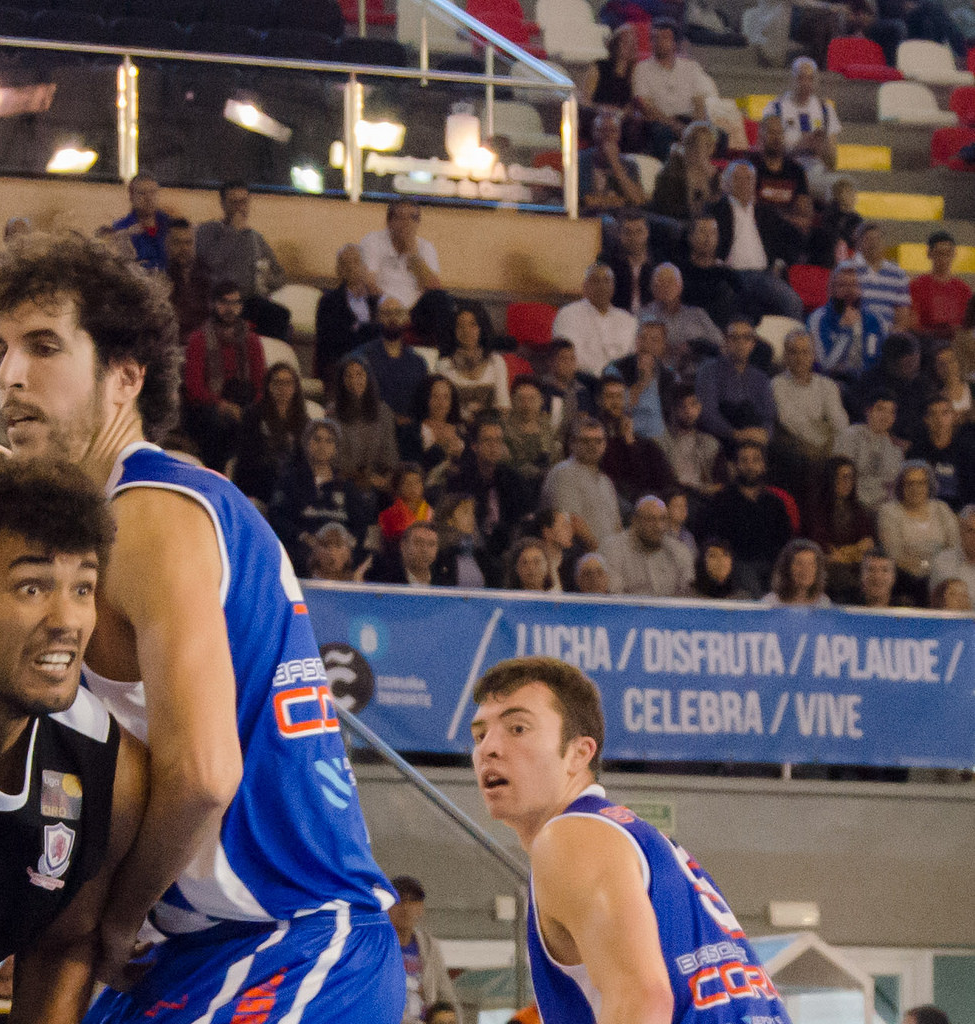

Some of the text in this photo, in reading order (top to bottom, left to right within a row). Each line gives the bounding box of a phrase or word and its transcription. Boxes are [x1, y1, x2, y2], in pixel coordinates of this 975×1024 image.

[643, 628, 786, 678] DISFRUTA
[813, 633, 941, 683] APLAUDE
[623, 688, 764, 736] CELEBRA
[795, 691, 864, 740] VIVE
